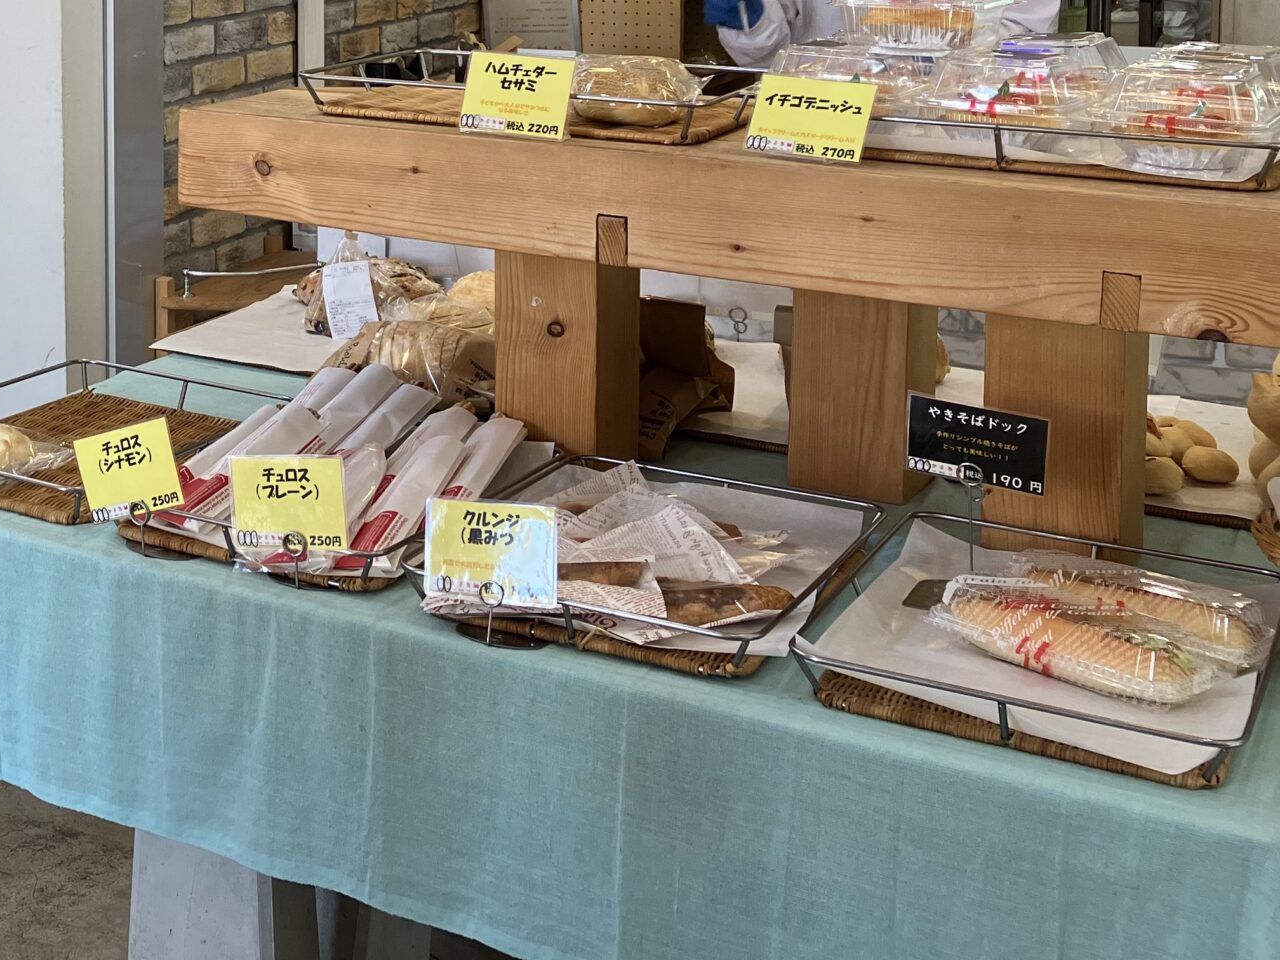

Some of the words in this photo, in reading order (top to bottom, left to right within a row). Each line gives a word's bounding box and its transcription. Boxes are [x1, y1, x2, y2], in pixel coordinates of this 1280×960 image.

[484, 61, 558, 78] ハムチェダー
[500, 76, 538, 92] セサミ
[765, 93, 863, 115] イチゴデニッシュ
[506, 120, 525, 132] 税込
[527, 123, 559, 135] 220円
[795, 143, 815, 154] 税込
[821, 146, 855, 160] 270円
[927, 405, 1028, 435] やきそばドック
[101, 434, 142, 456] チュロス
[98, 447, 152, 475] （シナモン）
[261, 467, 310, 483] チュロス
[991, 472, 1023, 489] 190
[1029, 481, 1042, 493] 円
[151, 491, 180, 507] 250円
[256, 483, 319, 500] （プレーン）
[463, 509, 520, 528] クルンジ
[309, 535, 342, 547] 250円
